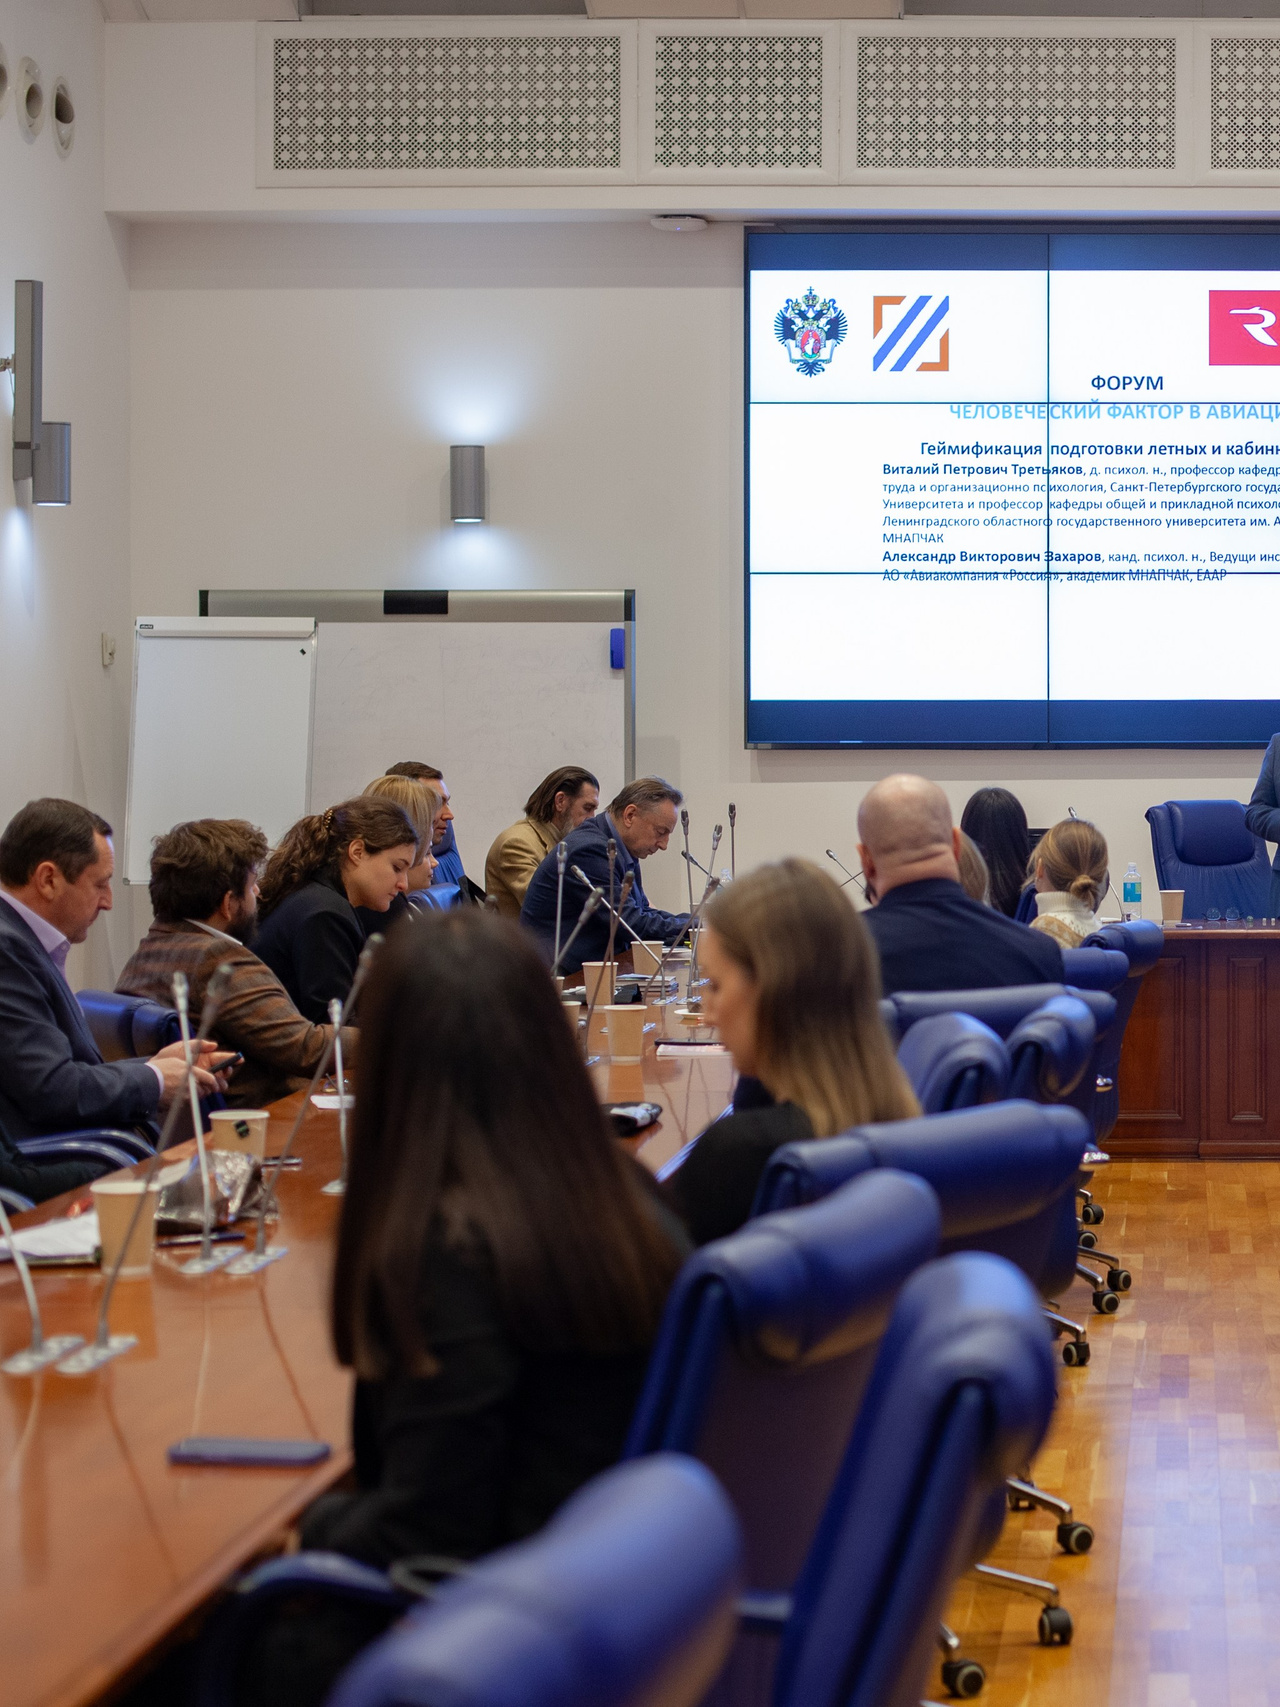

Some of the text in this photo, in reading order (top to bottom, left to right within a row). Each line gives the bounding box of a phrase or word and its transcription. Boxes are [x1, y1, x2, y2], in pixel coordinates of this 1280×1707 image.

[1090, 374, 1164, 391] ФОРУМ
[949, 398, 1102, 420] ЧЕЛОВЕЧЕСКИЙ
[1107, 402, 1184, 420] ФАКТОР
[1189, 403, 1202, 420] В
[920, 441, 1043, 459] Геймификация
[1049, 444, 1144, 459] подготовки
[1148, 444, 1208, 456] летных
[1212, 444, 1222, 456] и
[883, 463, 940, 475] Виталий
[943, 463, 1008, 478] Петрович
[1011, 463, 1087, 478] Третьяков,
[1089, 466, 1101, 477] д.
[1104, 466, 1149, 477] психол.
[1152, 466, 1167, 478] н.,
[1170, 463, 1236, 478] профессор
[882, 483, 916, 495] труда
[919, 483, 927, 492] и
[929, 483, 1030, 495] организационно
[1033, 483, 1107, 495] психология,
[1110, 481, 1243, 495] Санкт-Петербургского
[883, 499, 964, 512] Университета
[967, 500, 975, 509] и
[978, 498, 1043, 512] профессор
[1049, 498, 1103, 512] кафедры
[1105, 498, 1146, 512] общей
[1149, 500, 1157, 509] и
[1160, 498, 1234, 512] прикладной
[882, 516, 981, 529] Ленинградского
[983, 515, 1053, 527] областного
[1056, 517, 1162, 529] государственного
[1165, 517, 1246, 529] университета
[1250, 517, 1270, 527] им.
[882, 532, 945, 544] МНАПЧАК
[882, 550, 956, 565] Александр
[960, 551, 1041, 562] Викторович
[1043, 550, 1106, 565] Захаров,
[1108, 553, 1141, 565] канд.
[1144, 553, 1188, 564] психол.
[1191, 553, 1206, 564] н.,
[1209, 551, 1256, 564] Ведущи
[882, 569, 900, 581] АО
[1066, 570, 1125, 583] академик
